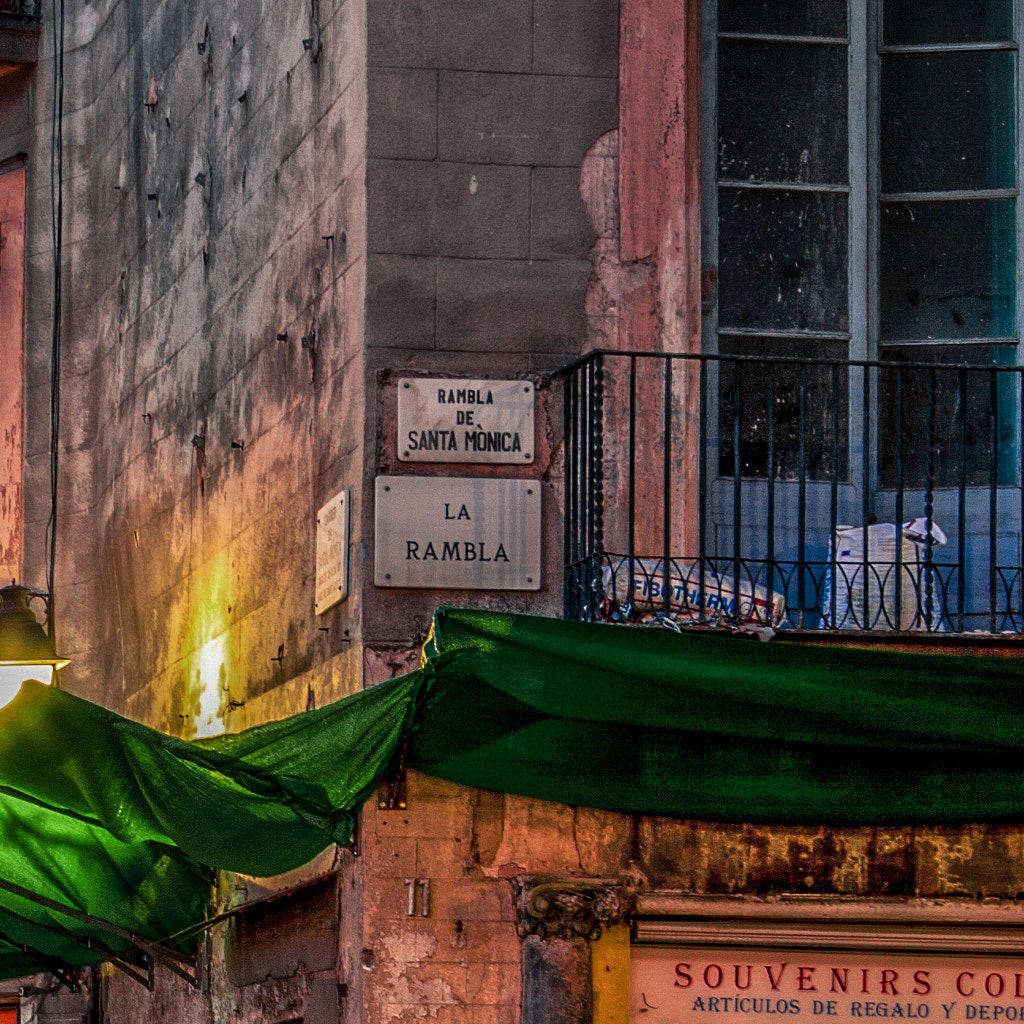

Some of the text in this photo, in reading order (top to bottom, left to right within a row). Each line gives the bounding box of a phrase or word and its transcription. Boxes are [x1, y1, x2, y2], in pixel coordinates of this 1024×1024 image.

[437, 389, 494, 405] RAMBLA
[456, 410, 475, 426] DE
[408, 424, 522, 452] SANTA MÒNICA
[444, 503, 471, 520] LA
[405, 540, 510, 562] RAMBLA
[674, 962, 1024, 998] SOUVENIRS COL
[691, 994, 801, 1015] ARTÍCULOS
[812, 1000, 838, 1016] DE
[850, 1001, 930, 1019] REGALO
[941, 1002, 956, 1019] Y
